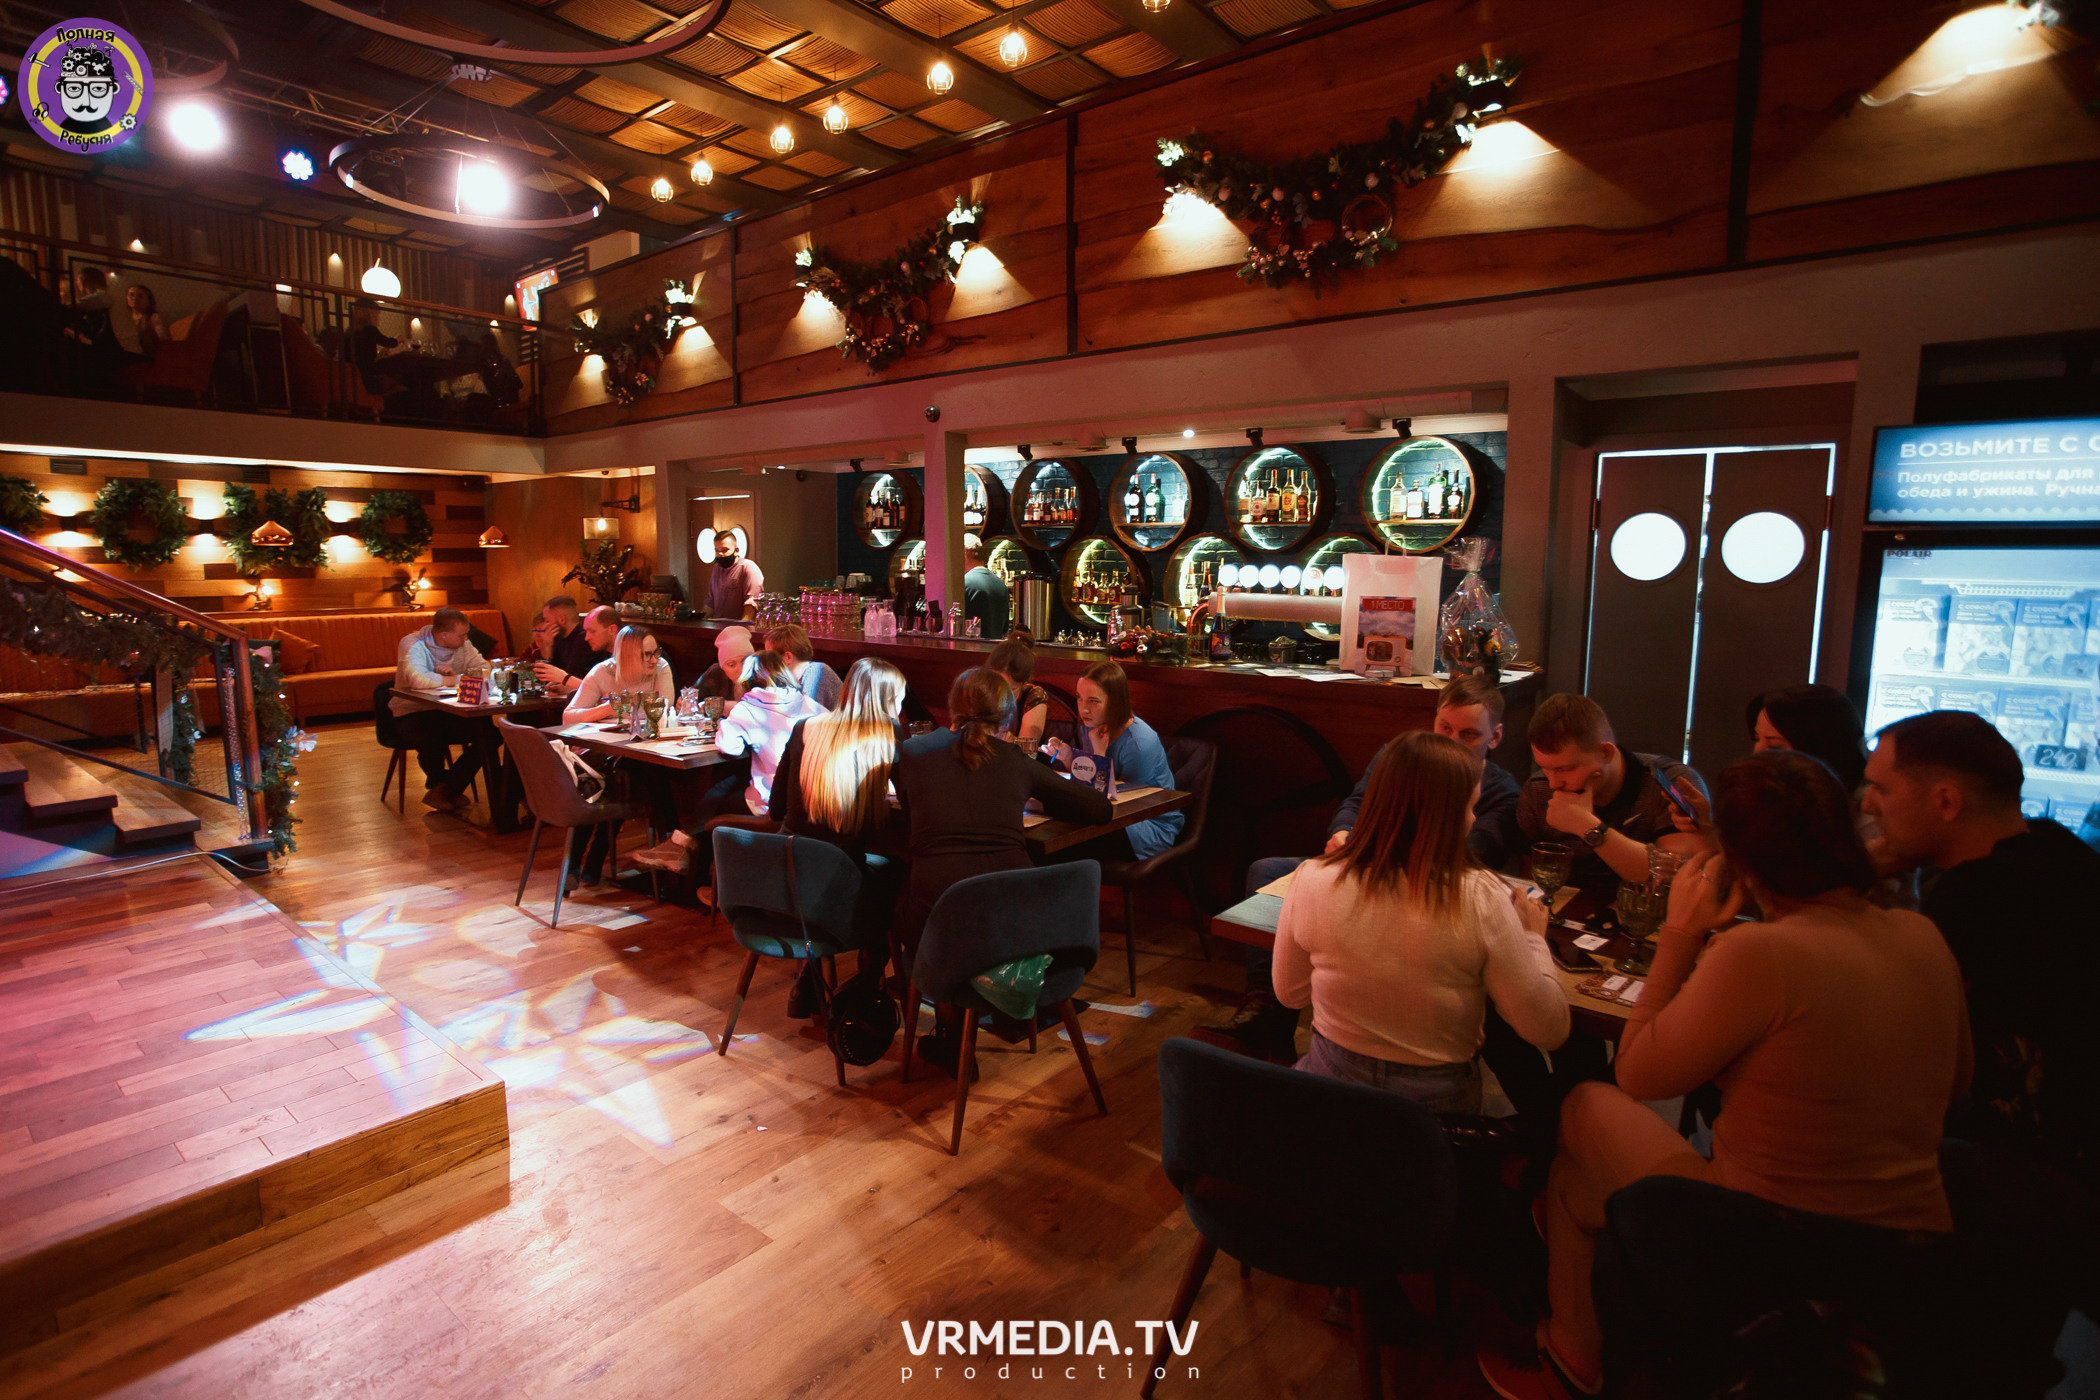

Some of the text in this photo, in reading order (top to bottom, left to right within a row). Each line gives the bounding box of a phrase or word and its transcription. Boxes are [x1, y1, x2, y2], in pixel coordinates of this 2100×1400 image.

[1899, 437, 2050, 459] ВОЗЬМИТЕ
[2059, 436, 2079, 453] С
[1897, 467, 2095, 484] Полуфабрикаты для
[1897, 486, 1951, 499] обеда
[1955, 487, 1969, 497] и
[1972, 486, 2038, 499] ужина.
[1886, 549, 1932, 558] POLAIR
[1376, 601, 1405, 610] МЕСТО
